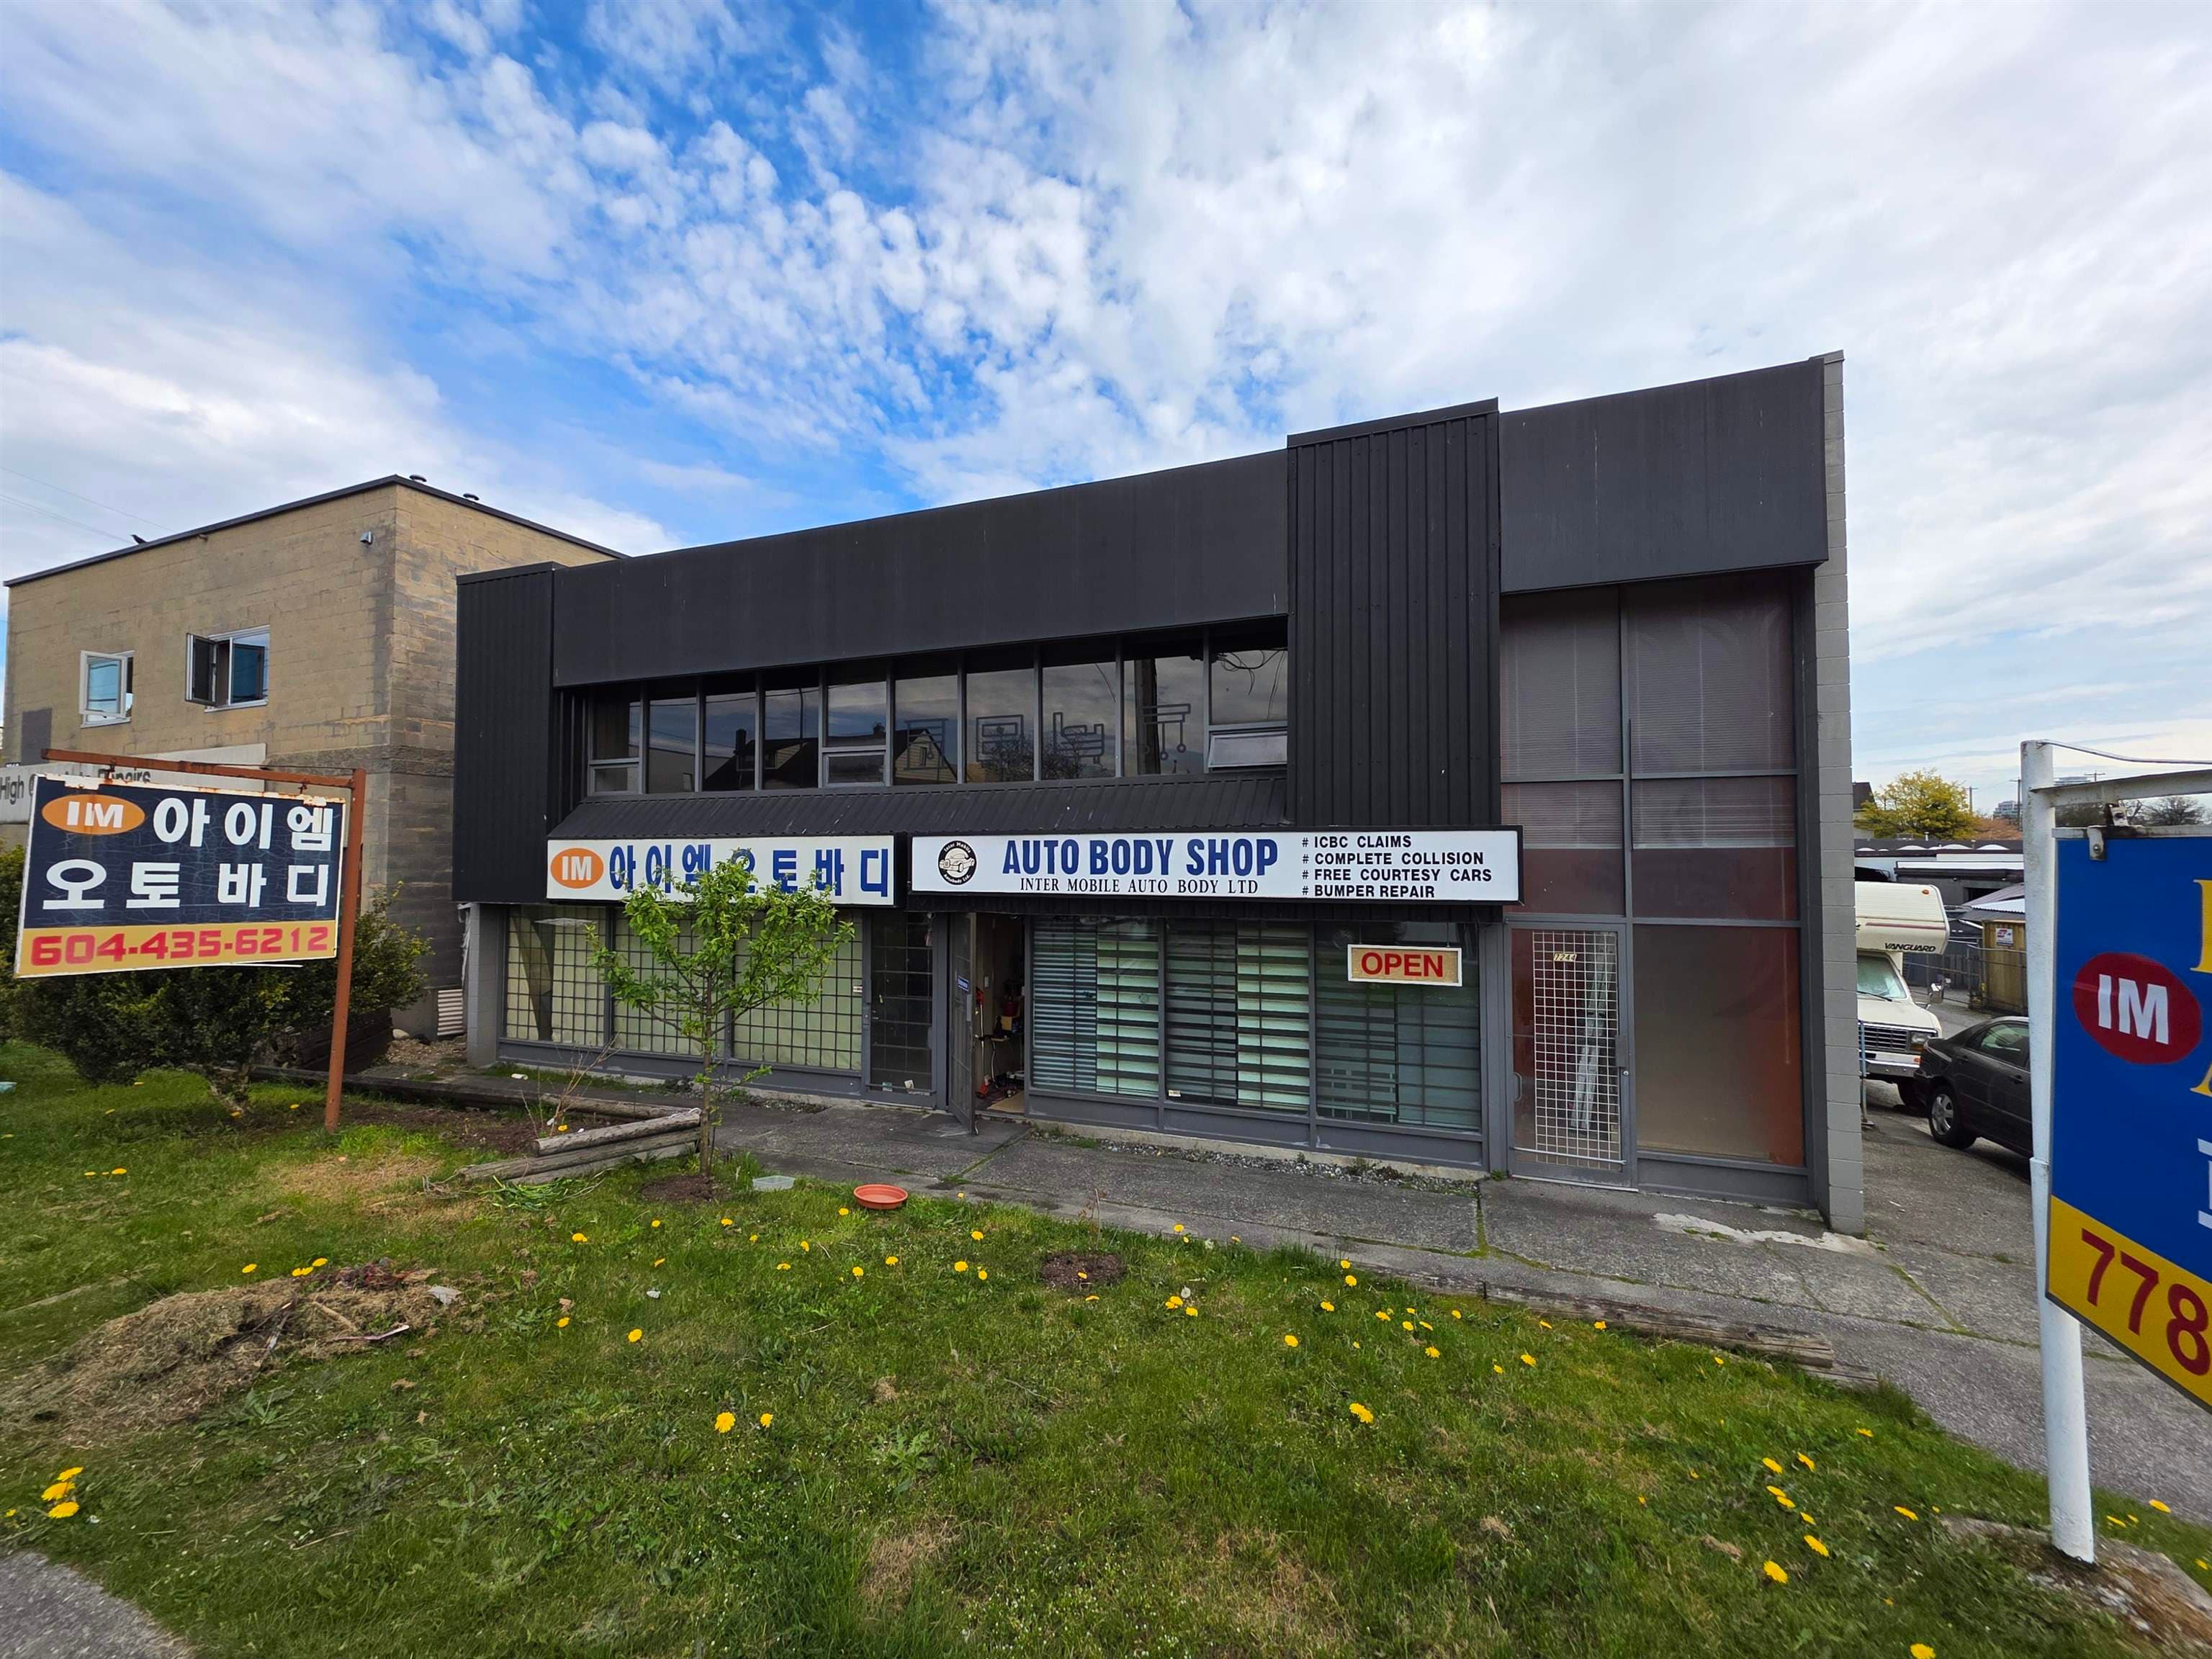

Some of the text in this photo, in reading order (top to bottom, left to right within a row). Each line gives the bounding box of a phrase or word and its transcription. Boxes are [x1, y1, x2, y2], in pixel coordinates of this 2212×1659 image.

[66, 801, 125, 828] IM
[1302, 835, 1412, 848] # ICBC CLAIMS
[562, 855, 593, 881] IM
[1002, 838, 1278, 876] AUTO BODY SHOP
[1302, 852, 1483, 865] # COMPLETE COLLISION
[1020, 878, 1259, 895] INTER MOBILE AUTO BODY LTD
[1302, 868, 1492, 882] # FREE COURTESY CARS
[1302, 885, 1435, 898] # BUMPER REPAIR
[30, 926, 329, 966] 604-435-6212
[1884, 943, 1936, 952] VANGUARD
[1361, 952, 1443, 977] OPEN
[2098, 974, 2170, 1045] IM
[2081, 1228, 2212, 1376] 778
